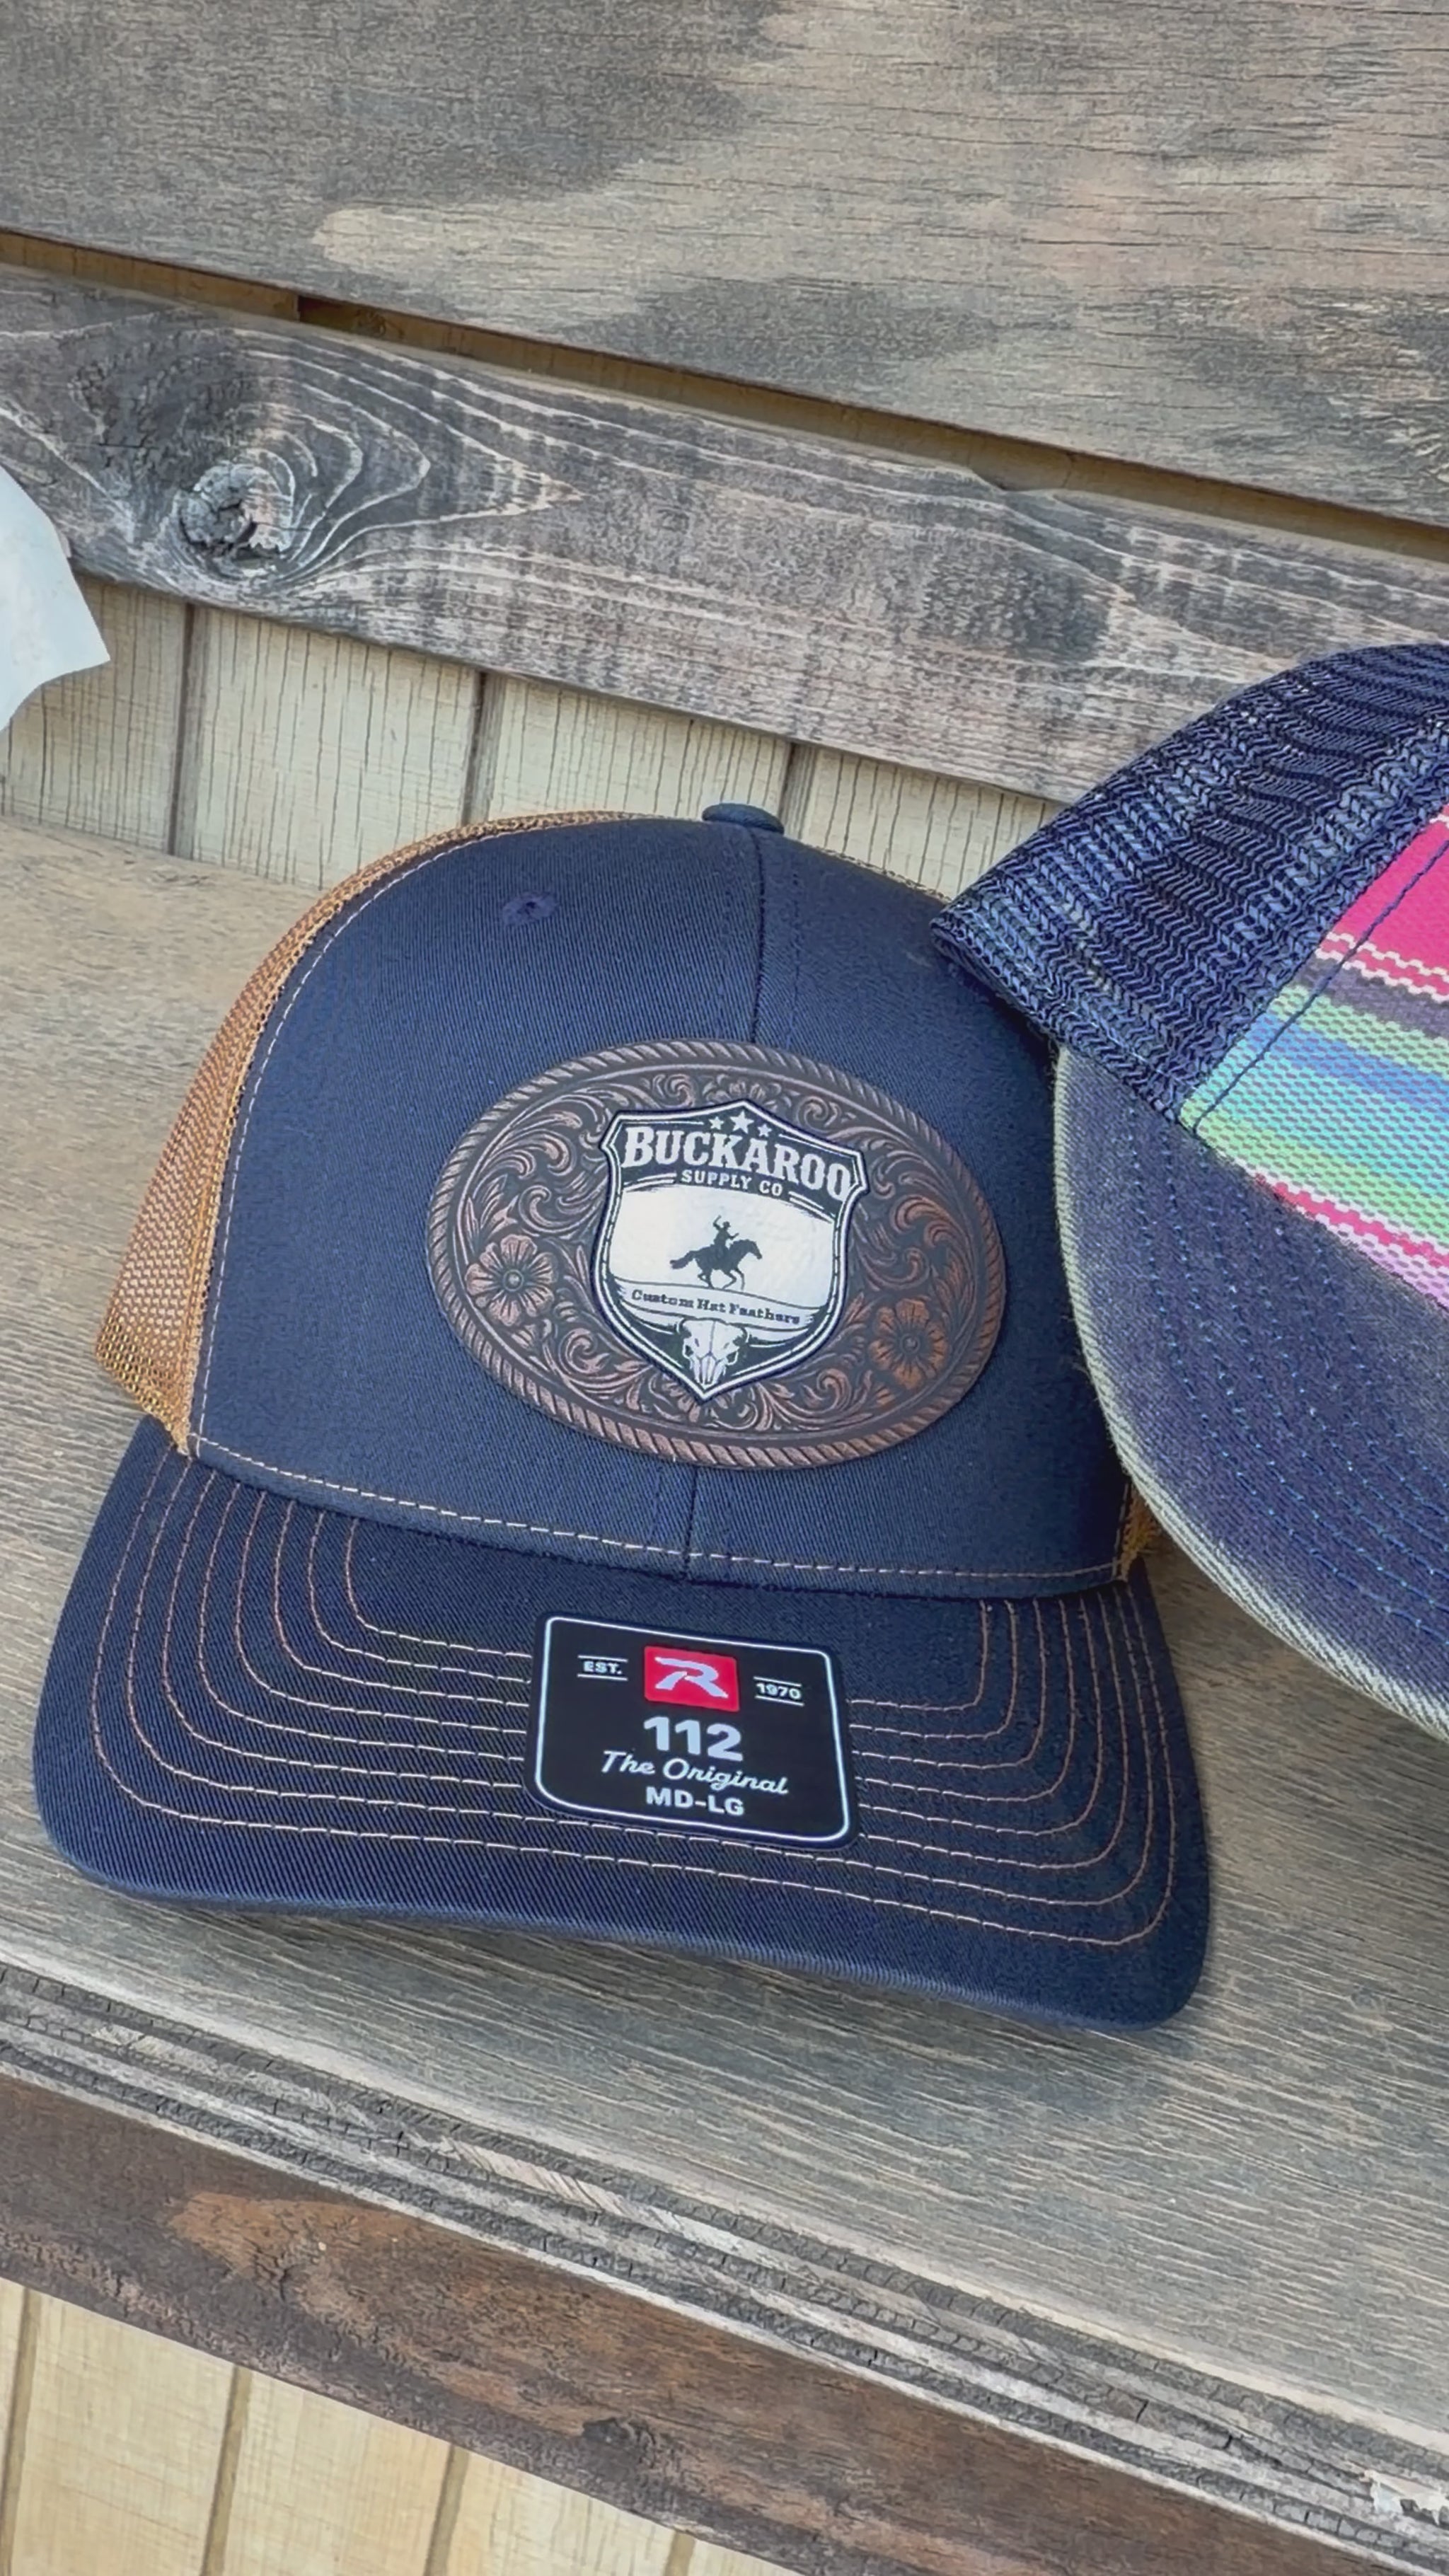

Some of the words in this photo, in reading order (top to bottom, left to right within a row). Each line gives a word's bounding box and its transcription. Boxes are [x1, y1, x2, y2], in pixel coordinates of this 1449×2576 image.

[622, 1126, 851, 1201] BUCKAROO
[681, 1169, 752, 1190] SUPPLY
[759, 1179, 783, 1197] CO
[631, 1290, 694, 1308] Custom
[697, 1298, 727, 1312] Hat
[583, 1660, 623, 1675] EST.
[756, 1682, 802, 1699] 1970
[644, 1716, 744, 1762] 112
[601, 1750, 655, 1774] The
[662, 1758, 789, 1795] Original
[646, 1786, 744, 1816] MD-LG
